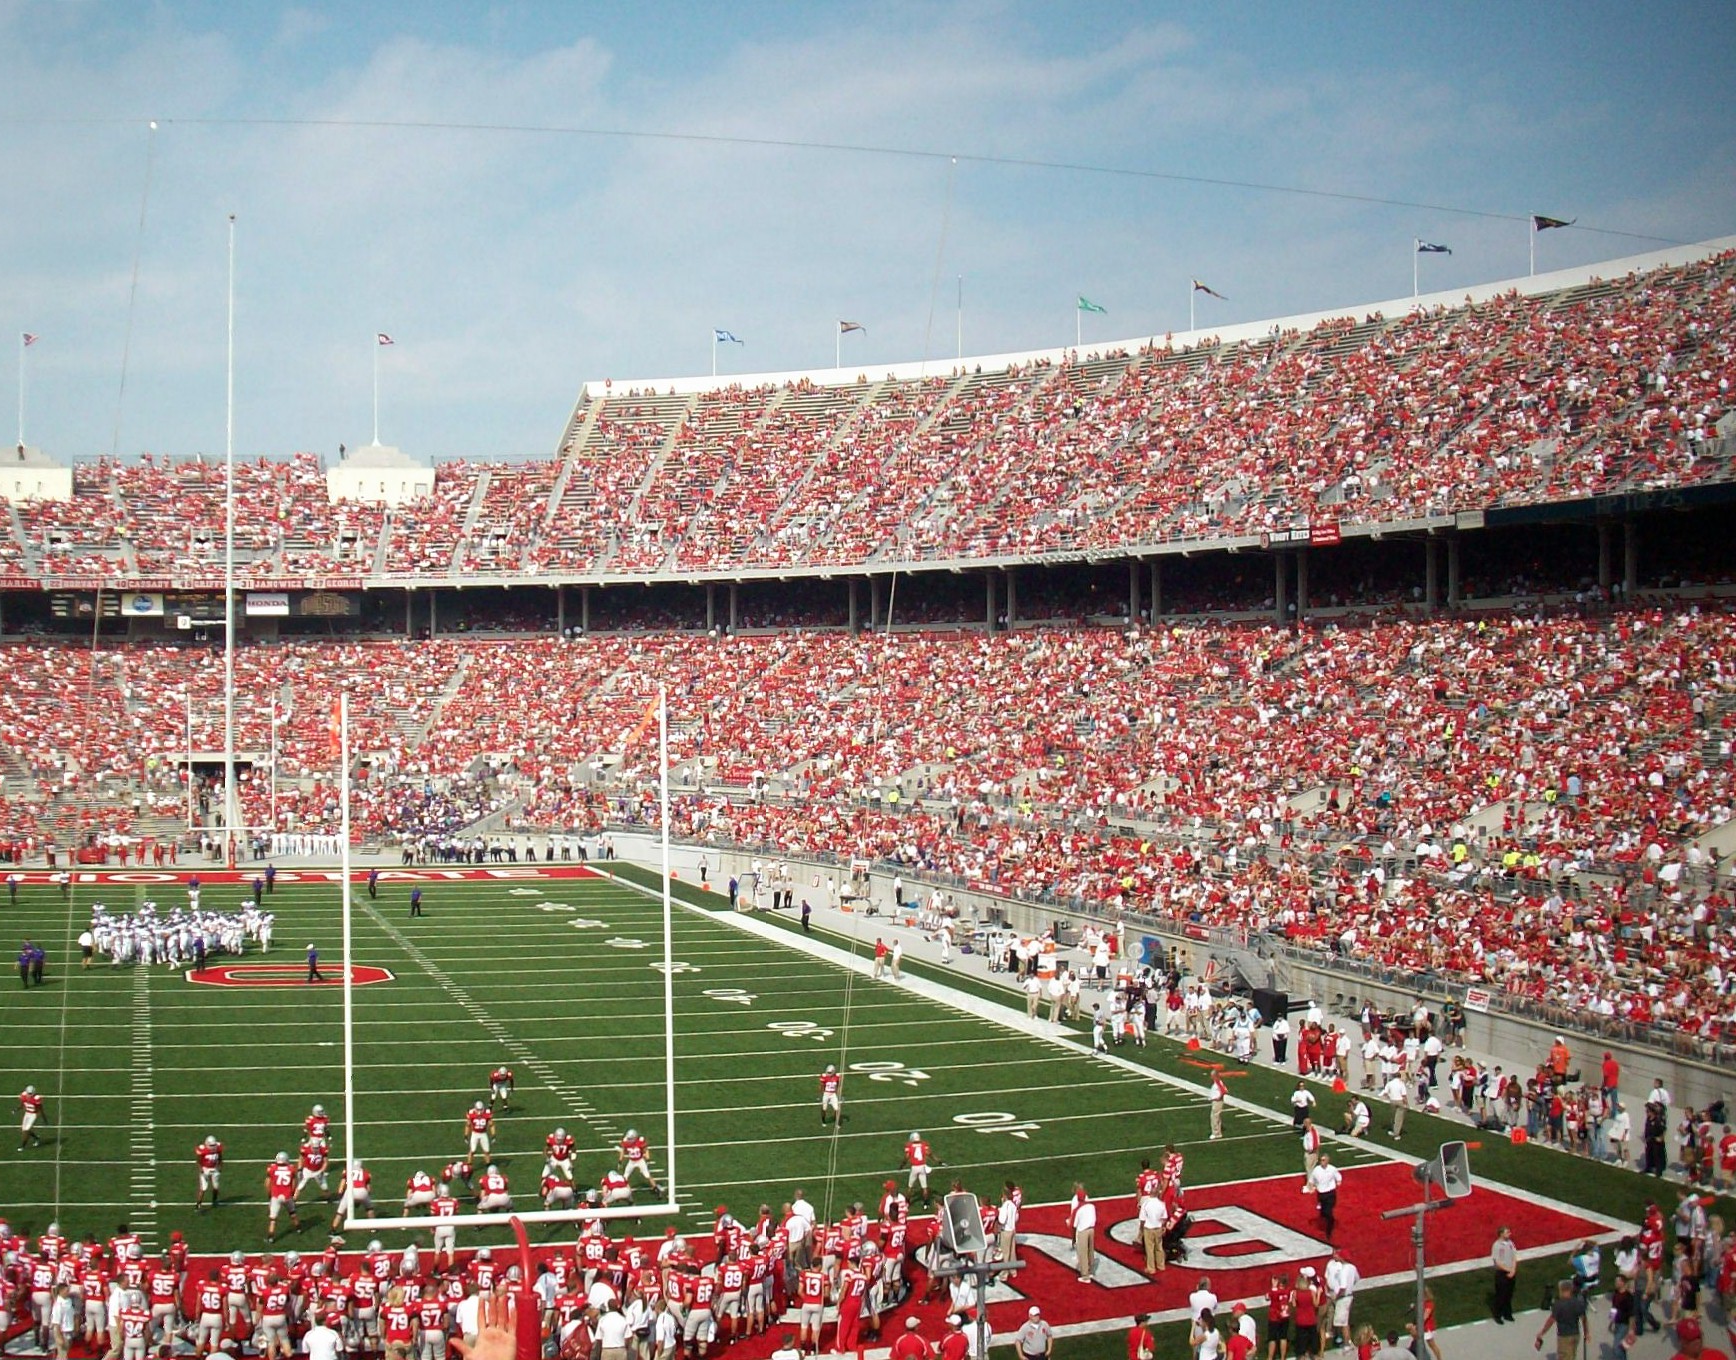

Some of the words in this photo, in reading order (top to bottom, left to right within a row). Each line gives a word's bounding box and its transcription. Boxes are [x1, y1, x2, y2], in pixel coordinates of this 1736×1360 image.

[325, 579, 361, 588] GEORGE
[238, 869, 551, 882] STATE
[765, 1020, 835, 1038] 30
[848, 1061, 932, 1082] 20
[951, 1111, 1042, 1134] 10
[914, 1145, 924, 1161] 4
[274, 1170, 292, 1186] 75
[729, 1234, 738, 1250] 5
[585, 1243, 604, 1260] 88
[630, 1252, 641, 1269] 6
[227, 1273, 246, 1290] 32
[477, 1271, 492, 1288] 16
[554, 1266, 566, 1284] 2
[723, 1271, 743, 1288] 89
[83, 1280, 102, 1297] 57
[152, 1279, 175, 1296] 95
[354, 1280, 377, 1298] 55
[805, 1277, 821, 1296] 13
[851, 1279, 866, 1297] 12
[202, 1292, 221, 1310] 46
[387, 1313, 409, 1330] 79
[420, 1309, 442, 1327] 67
[125, 1320, 144, 1338] 94
